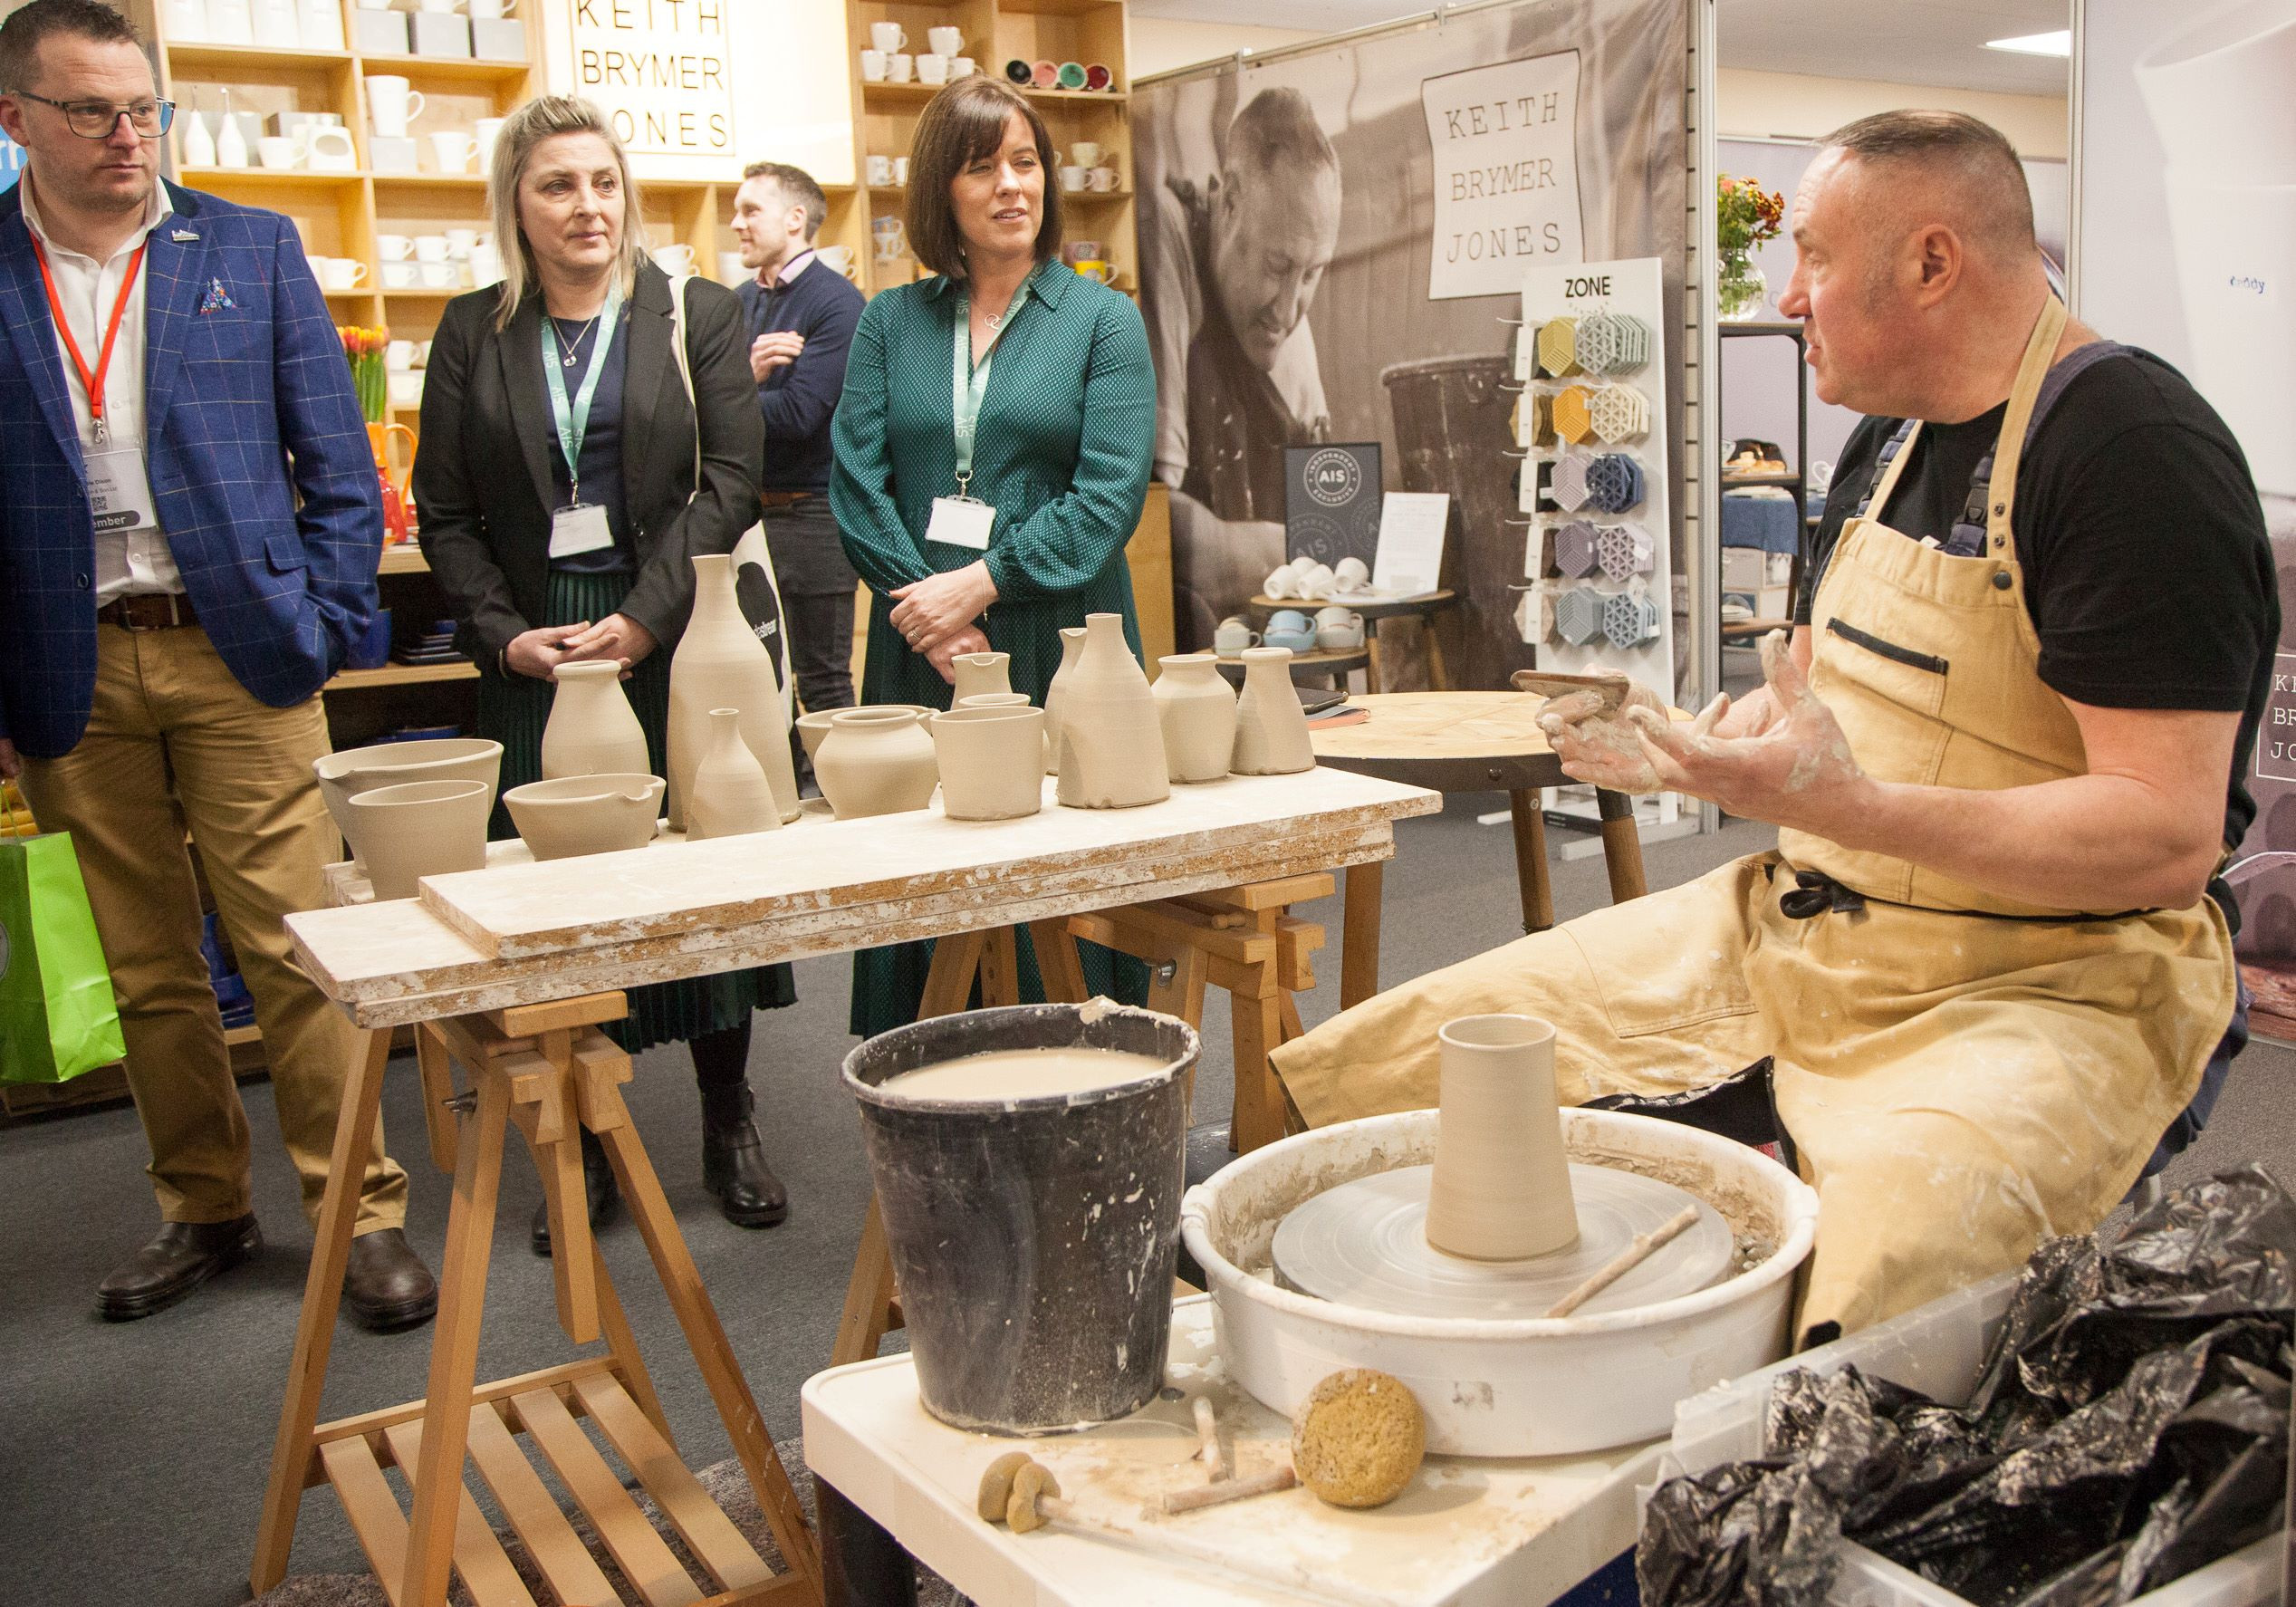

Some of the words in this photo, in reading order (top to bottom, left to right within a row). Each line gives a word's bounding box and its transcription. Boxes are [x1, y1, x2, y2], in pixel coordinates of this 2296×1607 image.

[578, 0, 720, 34] KEITH
[581, 50, 723, 90] BRYMER
[1445, 92, 1558, 139] KEITH
[612, 110, 726, 147] ONES
[1451, 158, 1556, 201] BRYMER
[1447, 222, 1561, 263] JONES
[1565, 275, 1610, 298] ZONE
[1006, 300, 1022, 317] AIS
[543, 351, 558, 368] AIS
[973, 372, 986, 392] AIS
[552, 387, 565, 404] AIS
[559, 427, 573, 448] AIS
[956, 417, 968, 438] AIS
[1319, 469, 1346, 483] AIS
